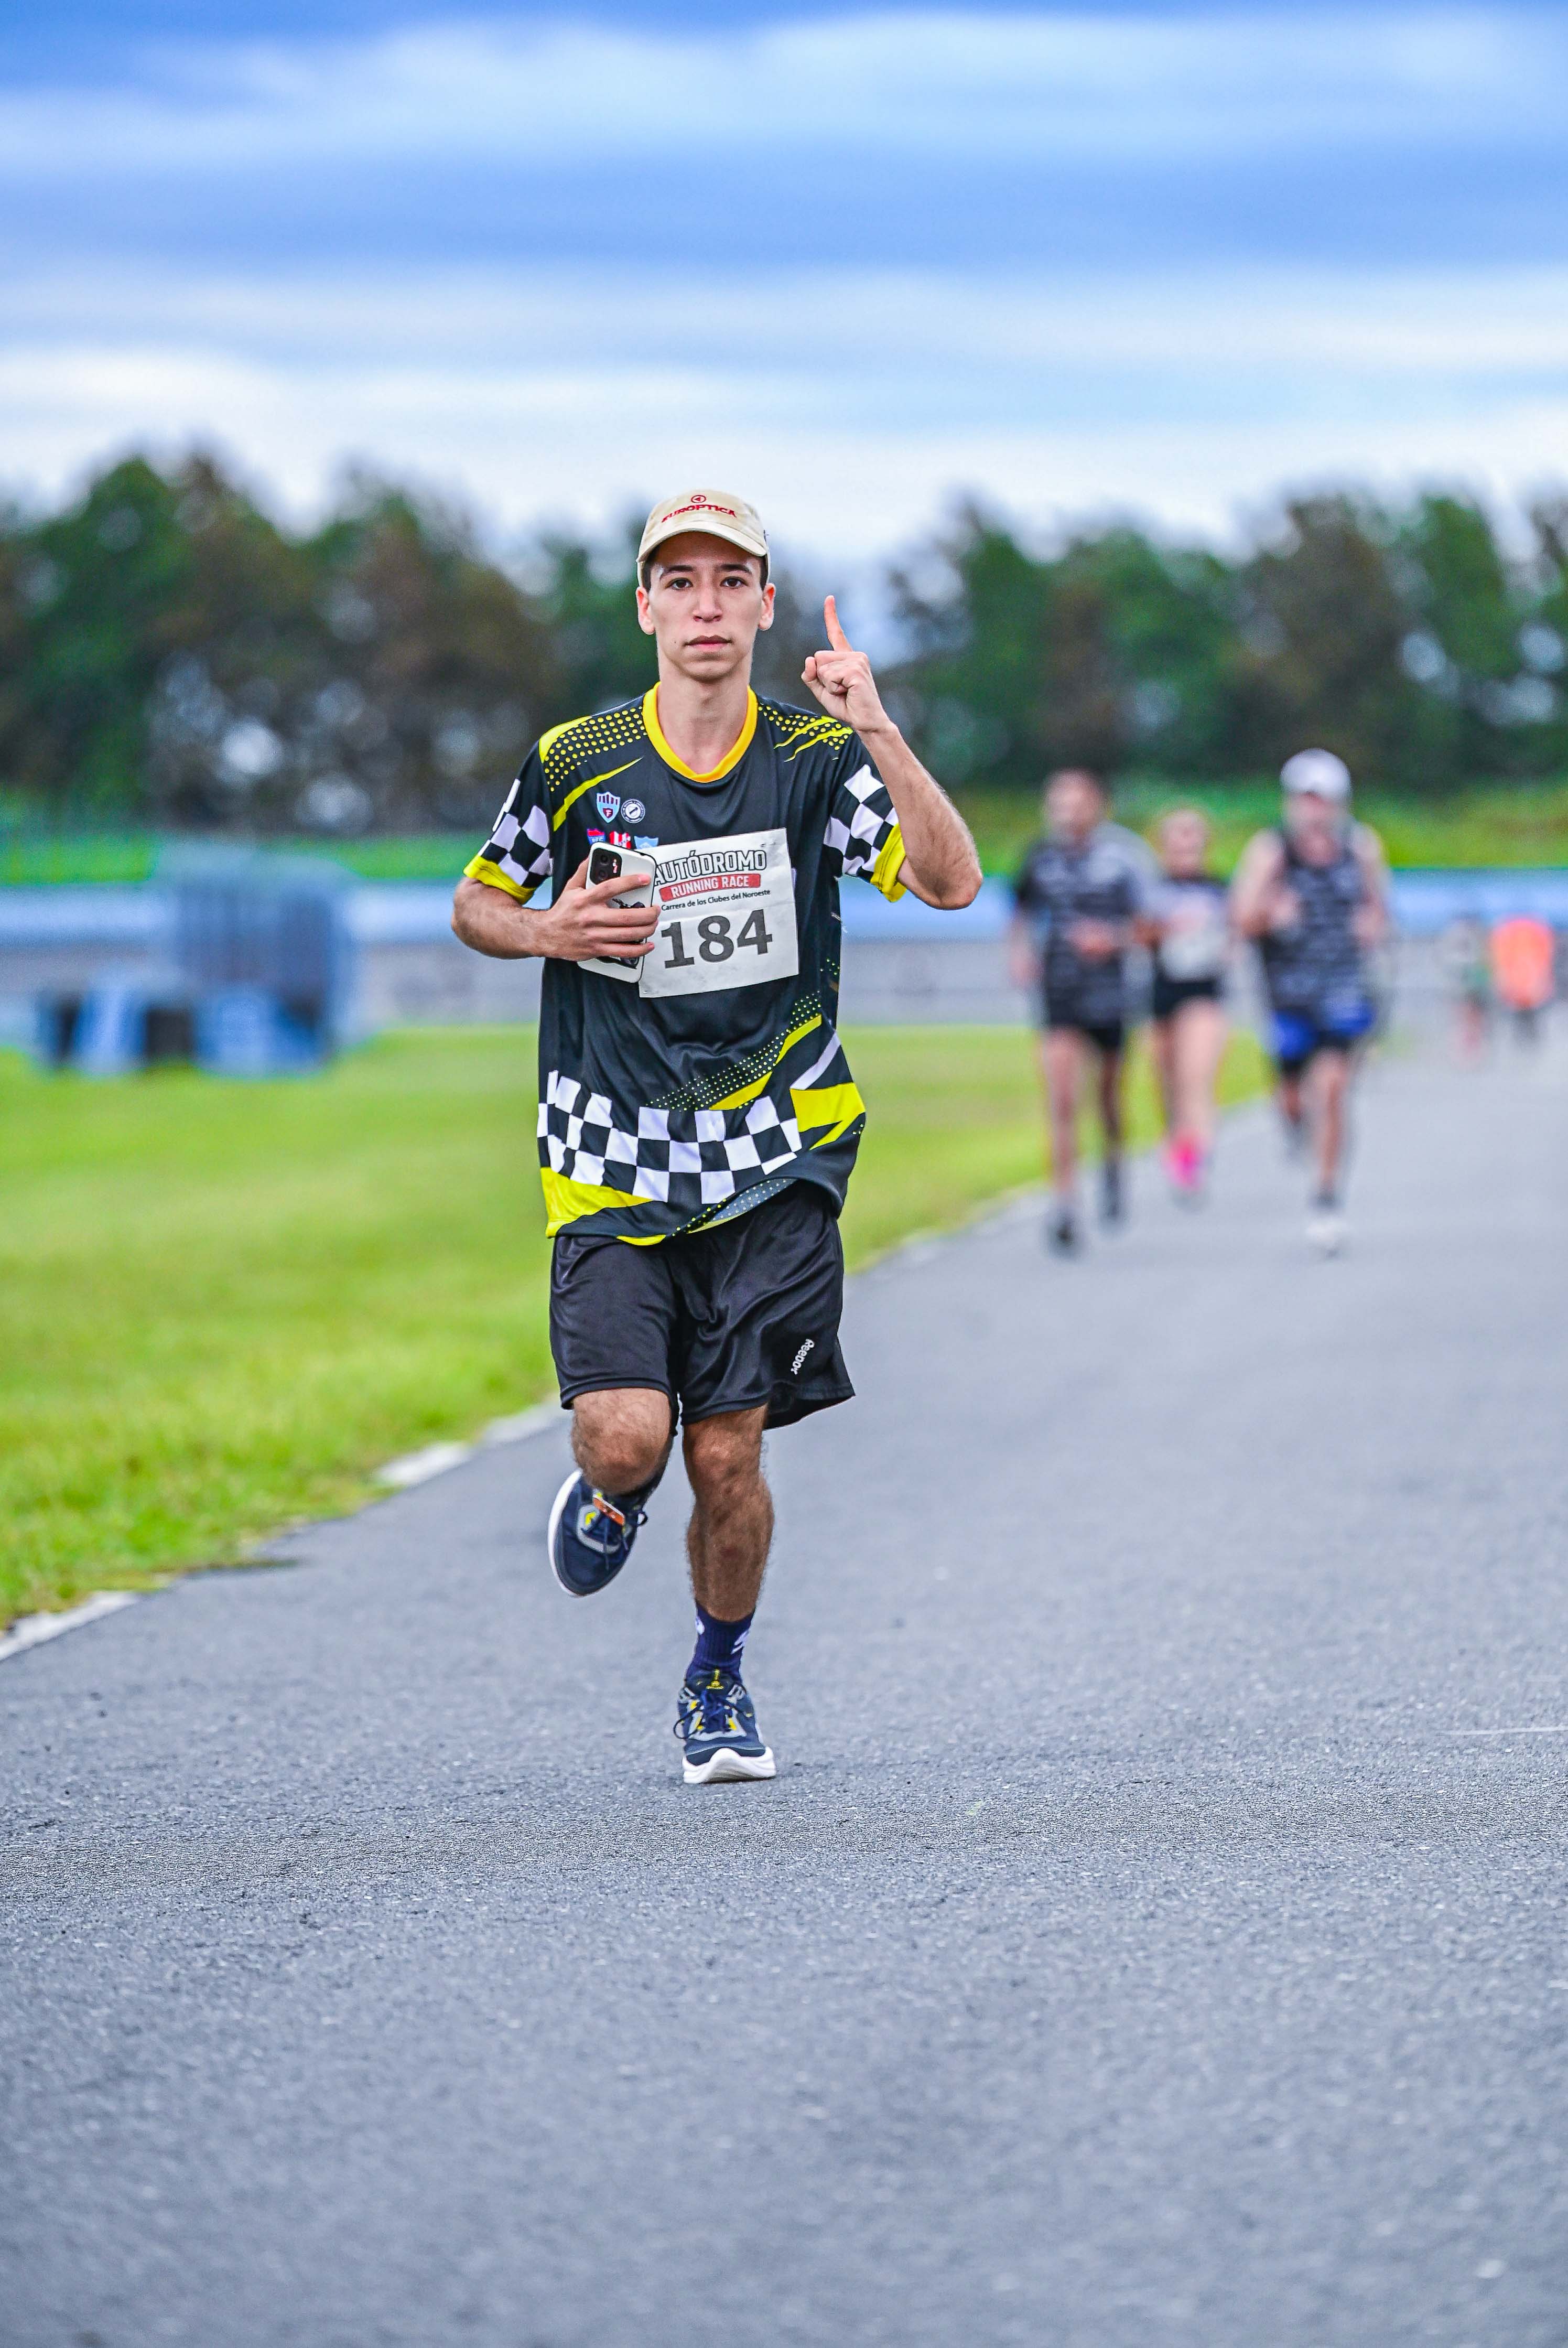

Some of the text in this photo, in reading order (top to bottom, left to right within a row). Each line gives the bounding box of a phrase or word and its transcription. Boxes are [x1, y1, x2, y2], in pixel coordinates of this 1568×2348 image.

[655, 850, 766, 886] AUTÓDROMO
[661, 901, 686, 911] Carrera
[687, 899, 696, 907] de
[708, 894, 730, 904] Clubes
[731, 891, 741, 900] del
[743, 890, 771, 899] Noroeste
[671, 875, 750, 898] RUNNING RACE
[661, 909, 773, 969] 184
